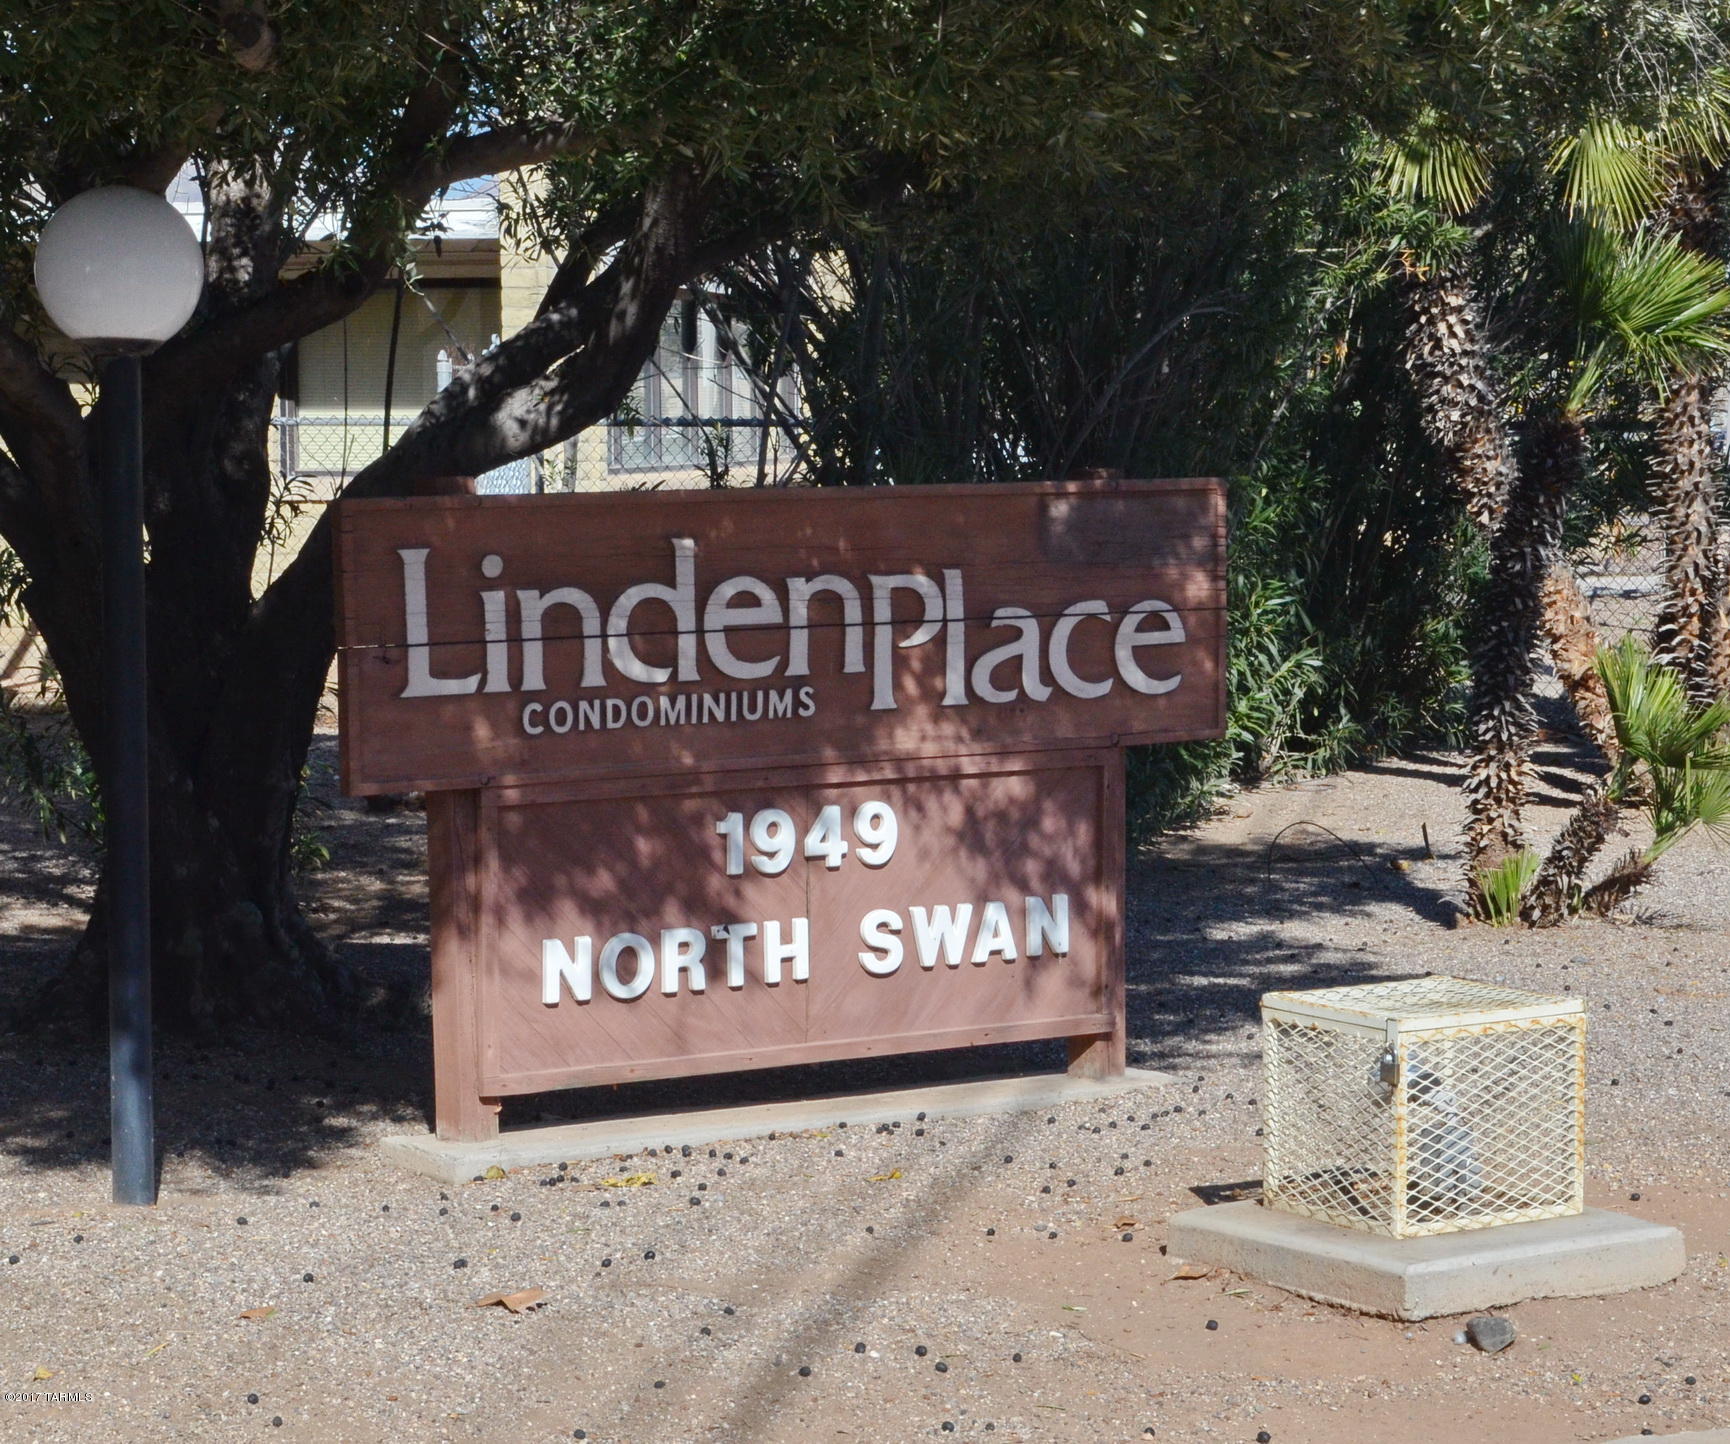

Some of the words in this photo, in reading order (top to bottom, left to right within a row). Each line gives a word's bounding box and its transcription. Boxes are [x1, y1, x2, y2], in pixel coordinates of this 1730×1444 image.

[521, 686, 816, 735] CONDOMINIUMS
[716, 800, 899, 876] 1949
[541, 917, 809, 1005] NORTH
[858, 893, 1070, 976] SWAN
